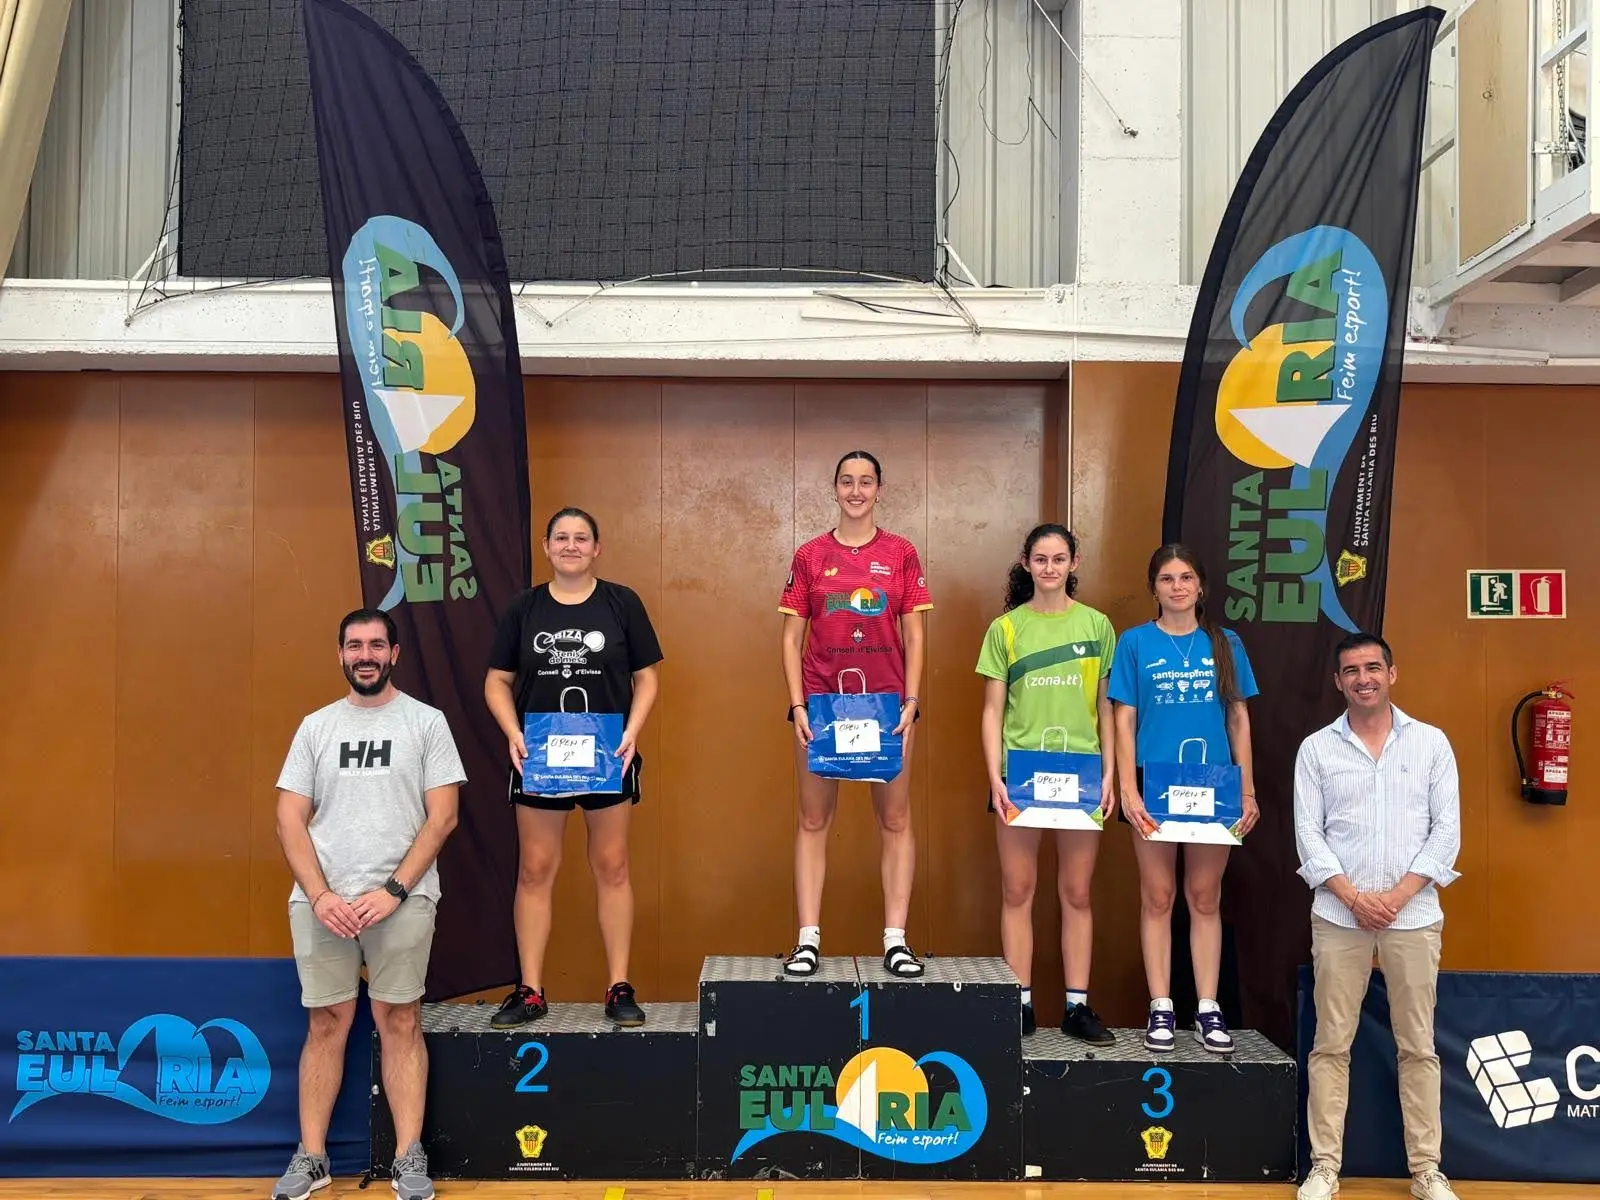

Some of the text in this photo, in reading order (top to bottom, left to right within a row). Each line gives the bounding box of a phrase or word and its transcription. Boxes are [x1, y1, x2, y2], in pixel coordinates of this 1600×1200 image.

[1337, 269, 1362, 400] Feim esport!
[1370, 414, 1378, 432] RIU
[1369, 436, 1377, 457] DES
[1353, 472, 1365, 547] AJUNTAMENT
[1361, 509, 1370, 546] SANTA
[1225, 470, 1264, 623] SANTA
[551, 737, 589, 748] OPEN F
[339, 739, 392, 769] HH
[1037, 775, 1071, 784] OPEN F
[1201, 790, 1208, 798] F
[850, 989, 869, 1040] 1
[16, 1030, 116, 1052] SANTA
[515, 1041, 549, 1092] 2
[739, 1065, 835, 1087] SANTA
[159, 1095, 241, 1111] Feim esport!
[1141, 1067, 1174, 1118] 3
[1567, 1105, 1599, 1117] MAT
[877, 1131, 960, 1150] Feim esport!
